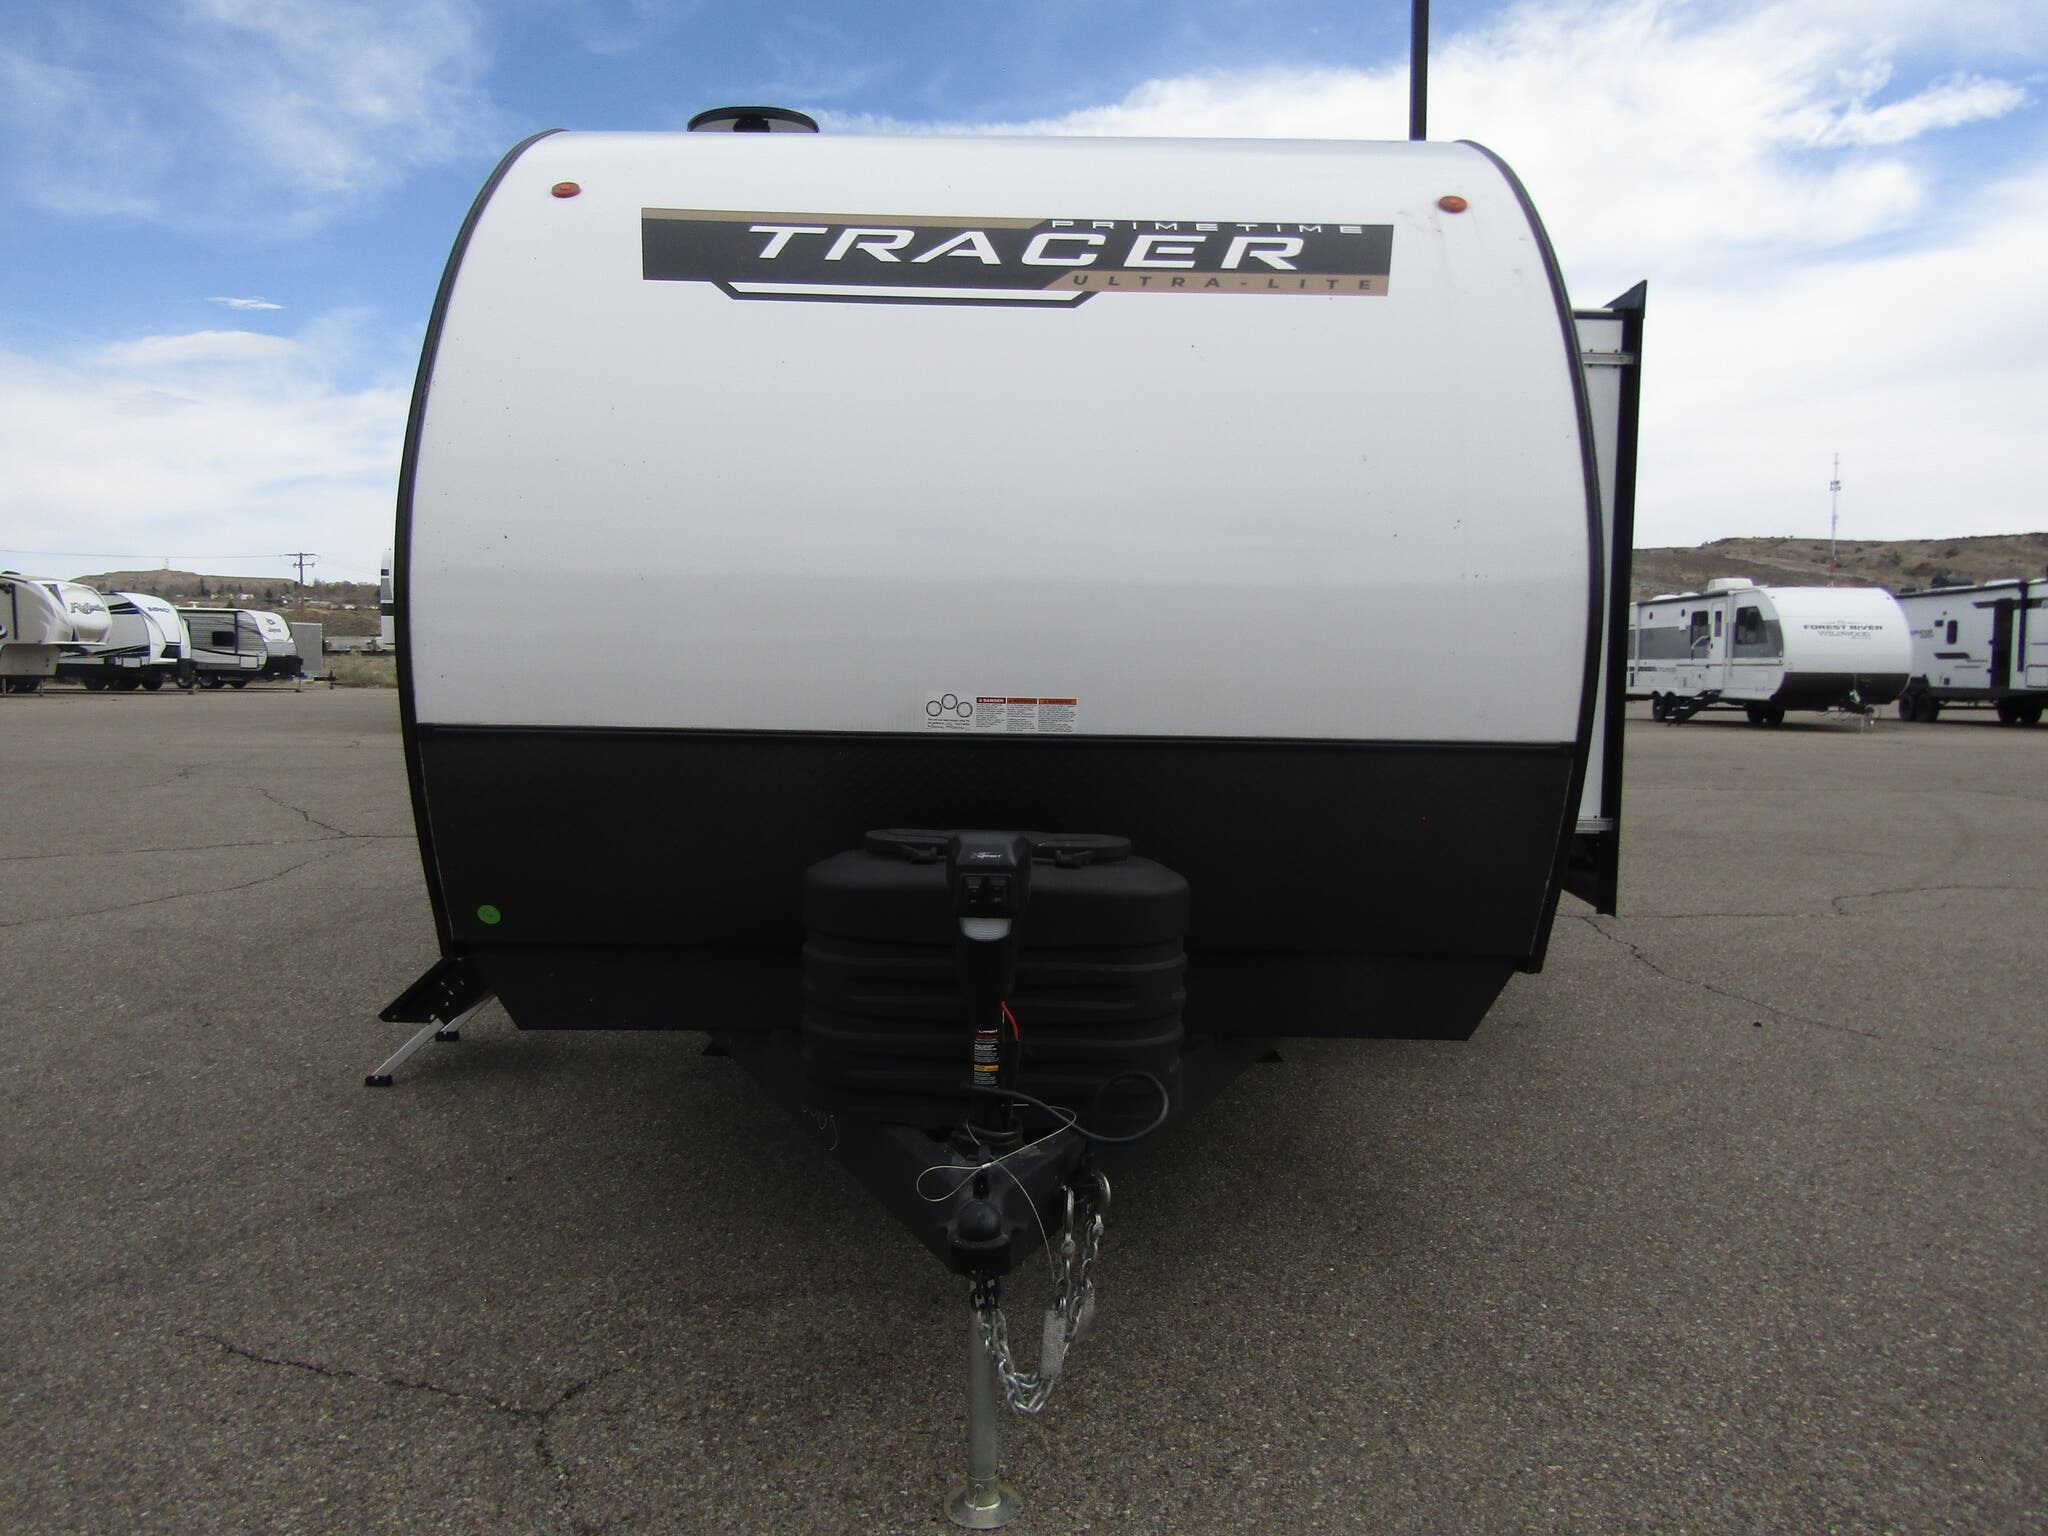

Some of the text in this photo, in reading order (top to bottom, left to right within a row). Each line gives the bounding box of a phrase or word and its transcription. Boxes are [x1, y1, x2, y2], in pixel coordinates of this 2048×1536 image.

[1051, 220, 1364, 235] PRIMETIME
[748, 225, 1303, 272] TRACER
[1072, 274, 1380, 291] ULTRA-LITE
